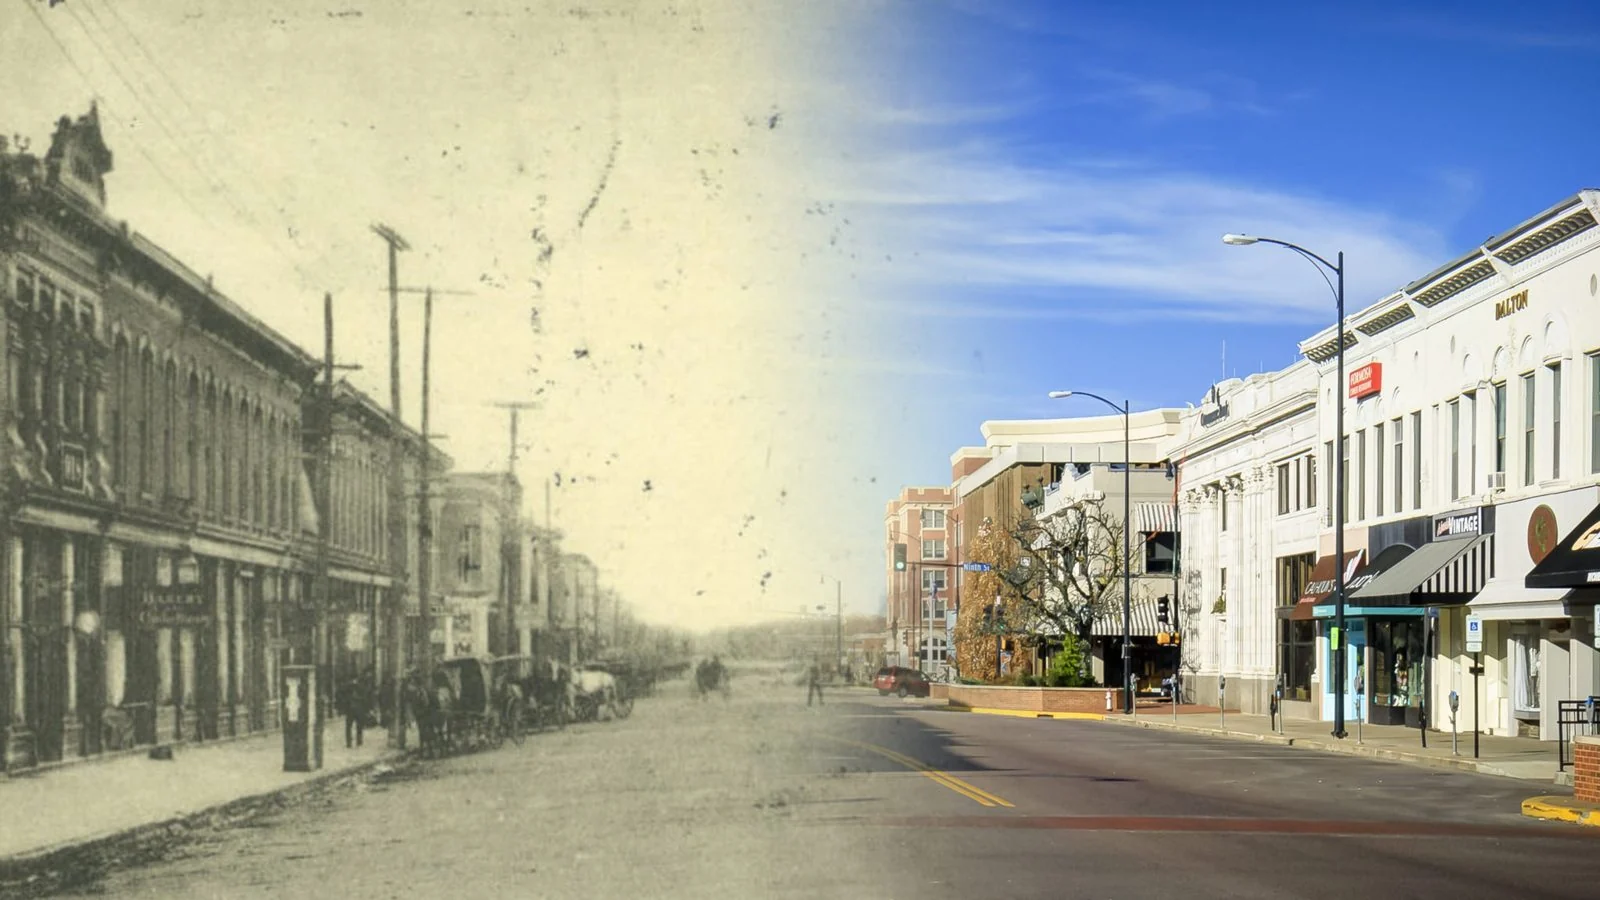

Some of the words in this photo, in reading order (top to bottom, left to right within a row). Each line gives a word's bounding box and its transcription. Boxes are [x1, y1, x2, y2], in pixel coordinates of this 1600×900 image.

[1495, 289, 1528, 320] DALTON
[1448, 515, 1478, 535] VINTAGE
[963, 563, 981, 571] Ninth
